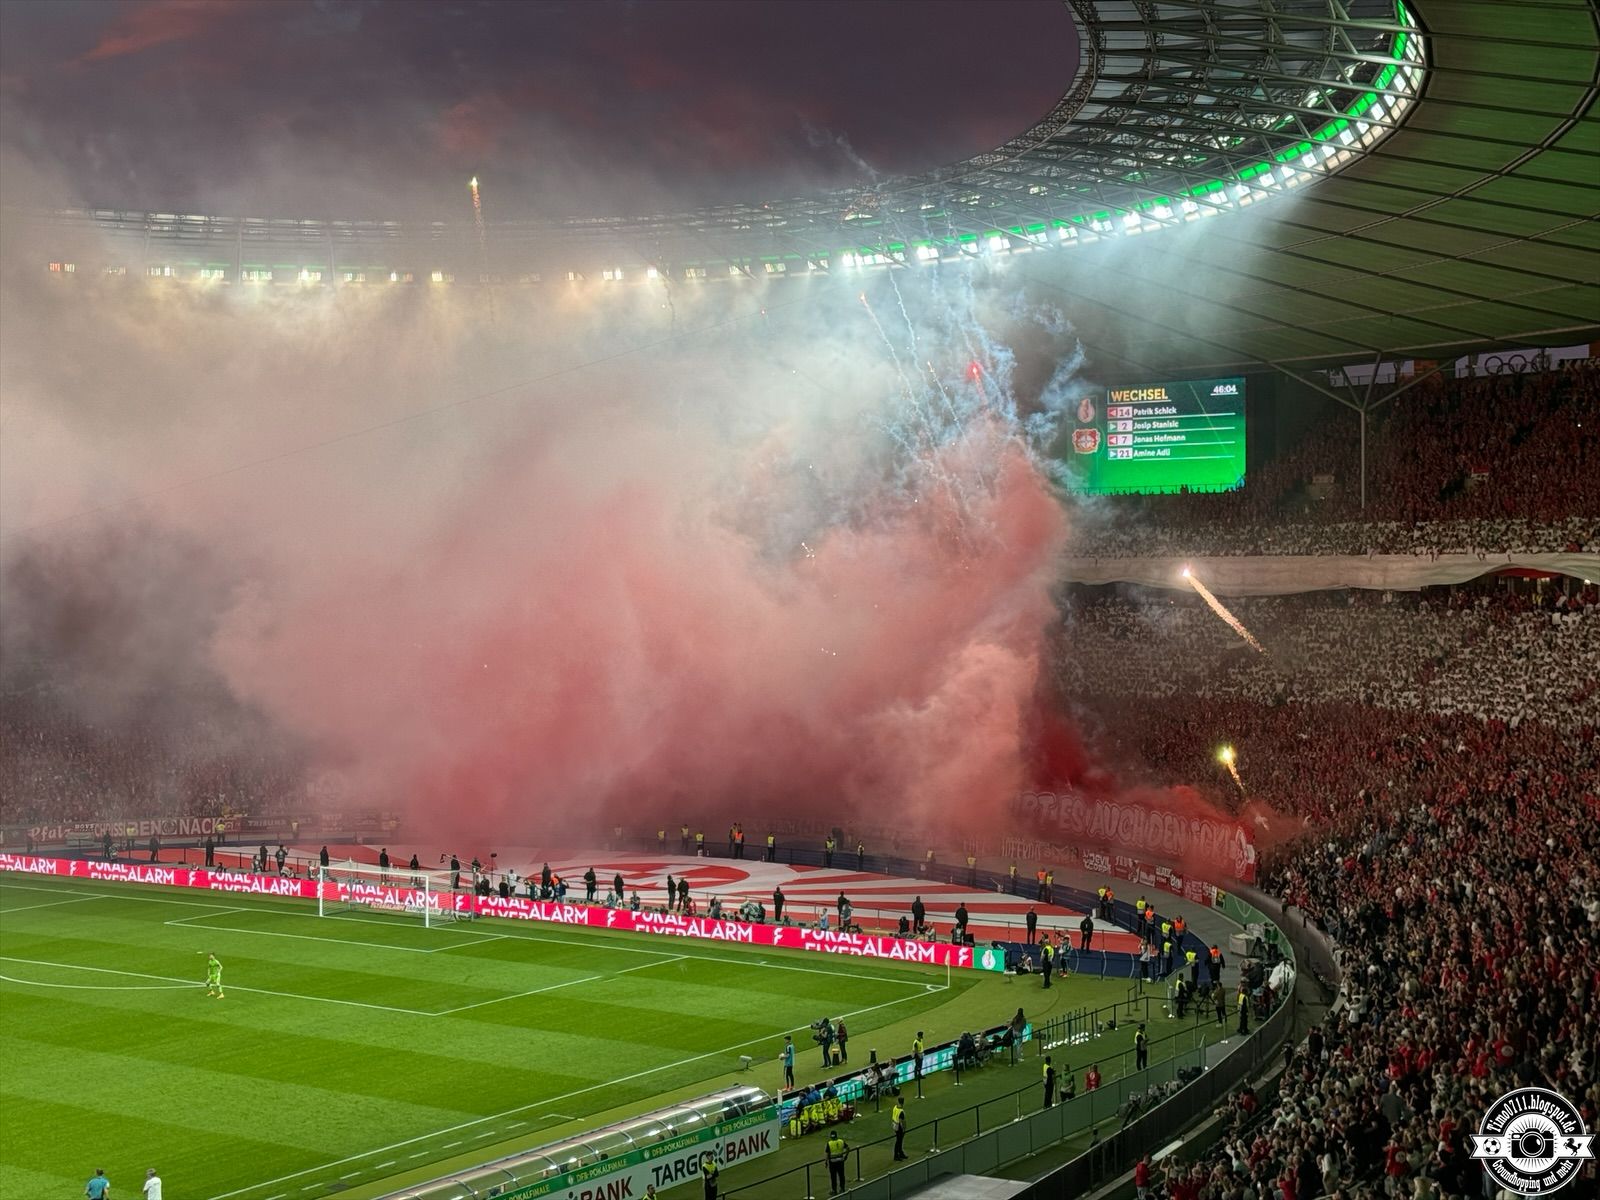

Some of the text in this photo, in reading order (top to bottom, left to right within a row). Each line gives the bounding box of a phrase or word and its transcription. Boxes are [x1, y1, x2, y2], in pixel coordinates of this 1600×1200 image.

[1110, 387, 1169, 402] WECHSEL
[1213, 384, 1237, 394] 46:04
[1119, 406, 1177, 417] 14 Patrik Schick
[1133, 421, 1152, 430] Josip
[1133, 435, 1153, 443] Jonas
[1153, 433, 1186, 442] Hofmann
[1119, 448, 1171, 458] 21 Amine Adli
[1087, 800, 1145, 847] AUCH
[651, 1135, 700, 1157] DFB-POKALFINALE
[726, 1129, 771, 1163] BANK
[576, 1159, 626, 1182] DFB-POKALFINALE
